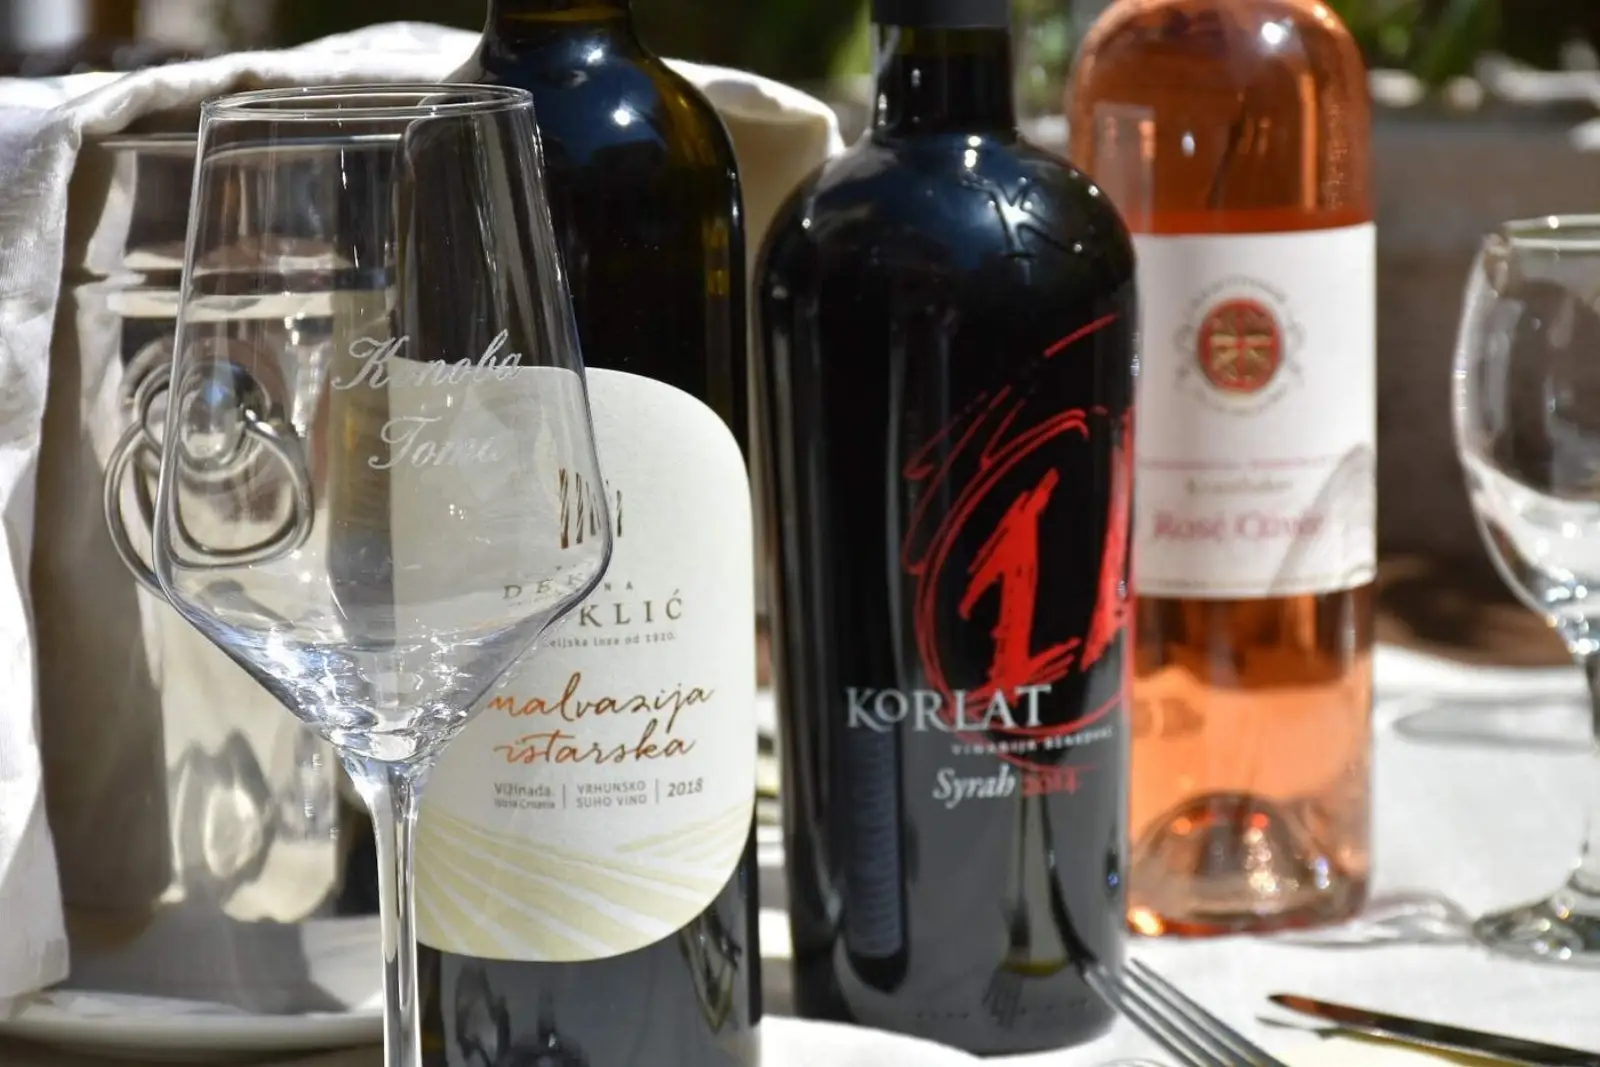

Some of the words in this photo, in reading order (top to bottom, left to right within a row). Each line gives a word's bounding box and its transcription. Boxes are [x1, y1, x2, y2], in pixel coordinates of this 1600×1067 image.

[846, 683, 1053, 733] KORLAT
[576, 780, 646, 795] VRHUNSKO
[666, 777, 705, 798] 2018
[932, 763, 1017, 809] Syrah
[575, 796, 612, 810] SUHO
[617, 794, 648, 807] VINO
